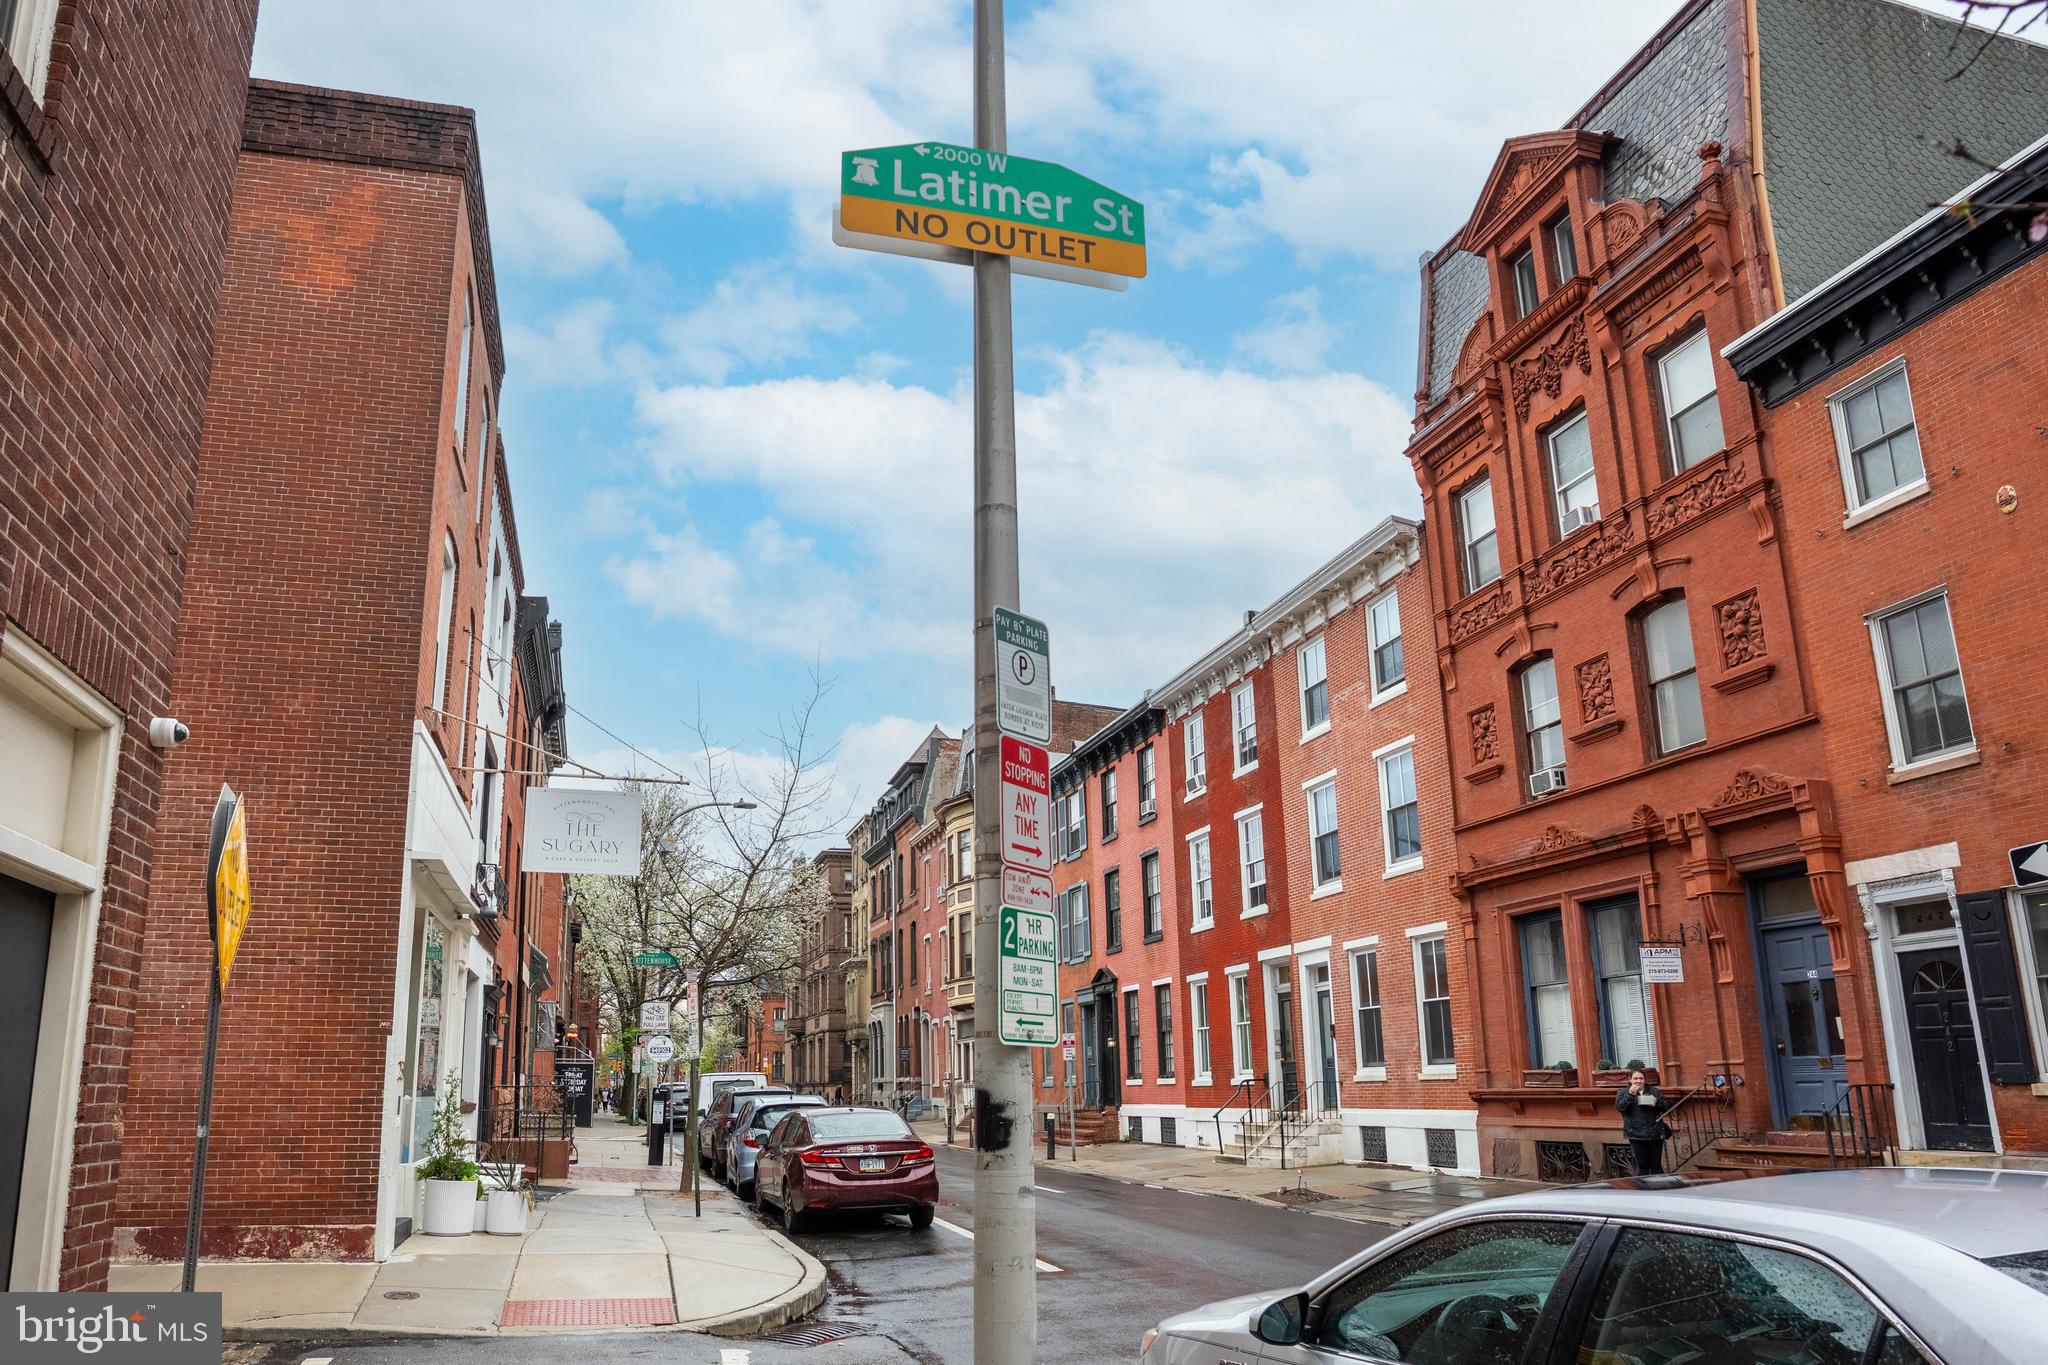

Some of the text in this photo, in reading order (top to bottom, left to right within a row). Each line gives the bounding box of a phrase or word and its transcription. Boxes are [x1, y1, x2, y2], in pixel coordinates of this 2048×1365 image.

[933, 145, 1008, 173] 2000 W
[894, 159, 1135, 237] Latimer St
[896, 208, 1097, 264] NO OUTLET
[996, 614, 1010, 628] PAY
[1026, 625, 1047, 642] PLATE
[1006, 630, 1039, 651] PARKING
[1019, 655, 1028, 678] P
[1018, 745, 1031, 764] NO
[1005, 761, 1046, 789] STOPPING
[1015, 792, 1037, 816] ANY
[565, 812, 605, 838] THE
[1014, 814, 1039, 840] TIME
[542, 838, 623, 855] SUGARY
[1004, 916, 1042, 950] 2 HR
[1018, 937, 1054, 958] PARKING
[1013, 976, 1044, 989] MON-SAT
